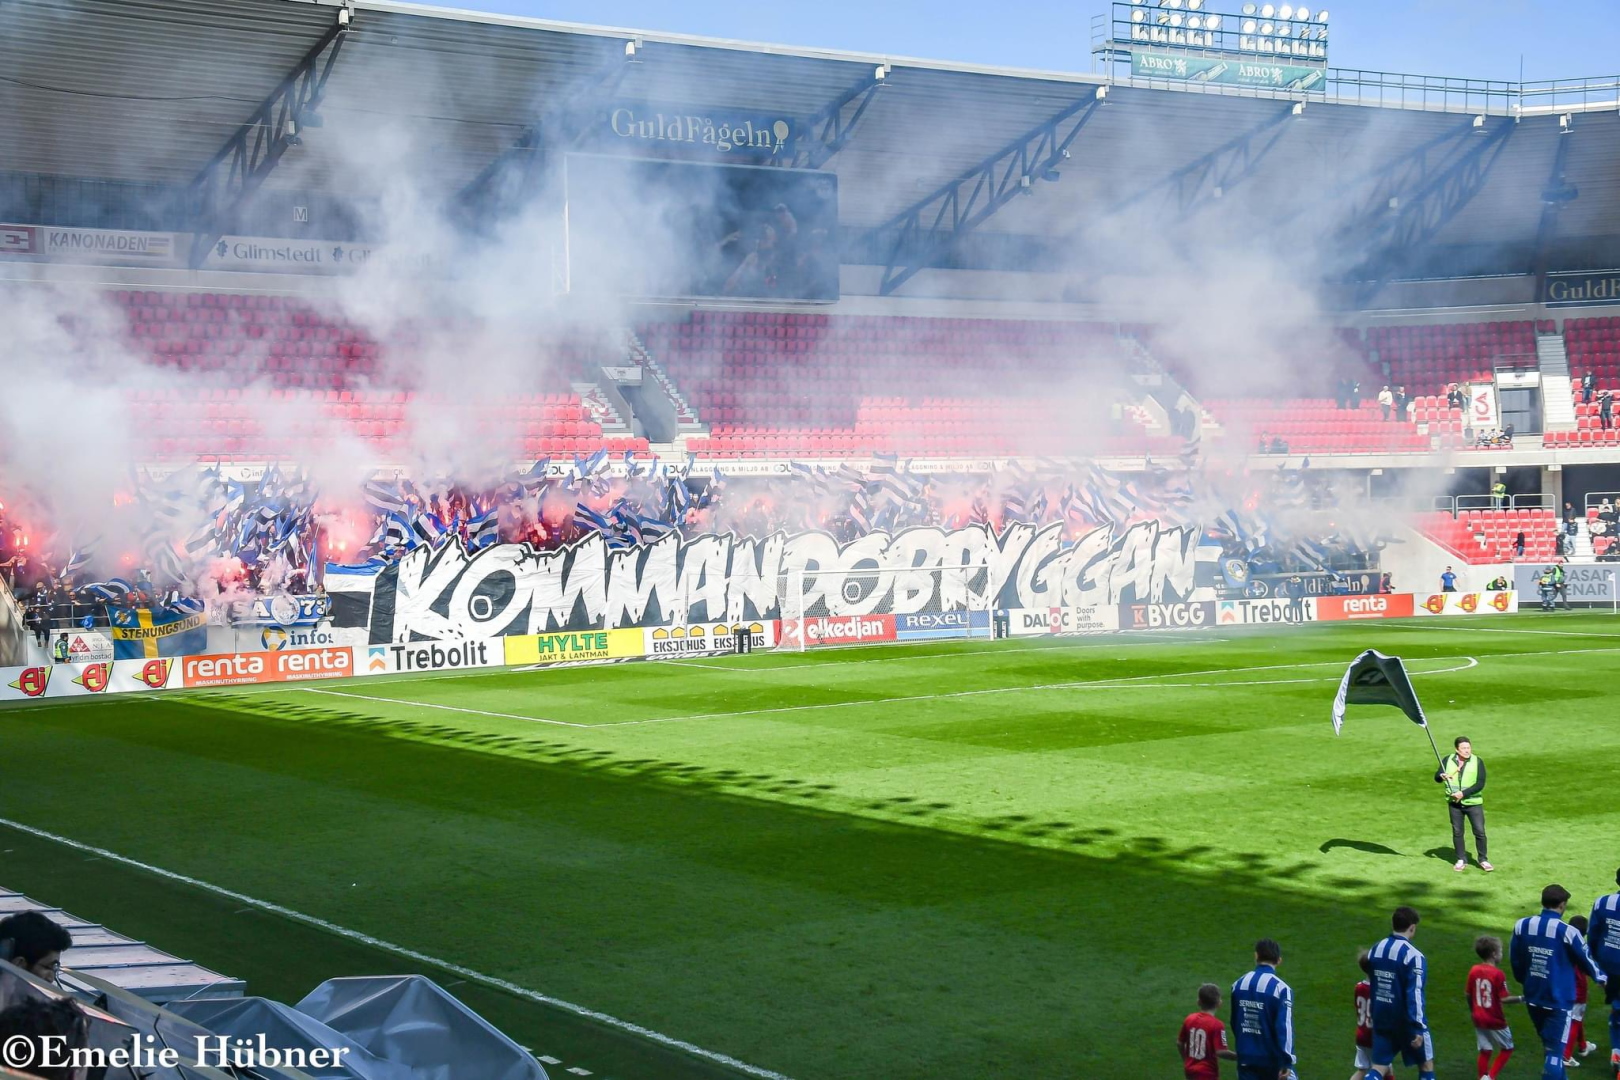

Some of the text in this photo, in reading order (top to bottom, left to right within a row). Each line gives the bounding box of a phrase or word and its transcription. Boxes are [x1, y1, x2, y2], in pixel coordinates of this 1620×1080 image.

[611, 108, 771, 151] GuldFågeln
[50, 232, 148, 250] KANONADEN
[234, 243, 322, 262] Glimstedt
[1076, 606, 1096, 615] Doors
[1148, 602, 1205, 626] BYGG
[1343, 596, 1387, 612] renta
[121, 616, 200, 639] STENUNGSUND
[808, 617, 884, 640] elkedjan
[1023, 611, 1069, 628] DALOC
[1076, 614, 1091, 622] with
[538, 632, 608, 654] HYLTE
[187, 655, 264, 678] renta
[278, 649, 349, 672] renta
[390, 641, 488, 671] Trebolit
[540, 650, 609, 661] JAKT & LANTMAN
[1475, 978, 1492, 1009] 13
[1189, 1027, 1207, 1060] 10
